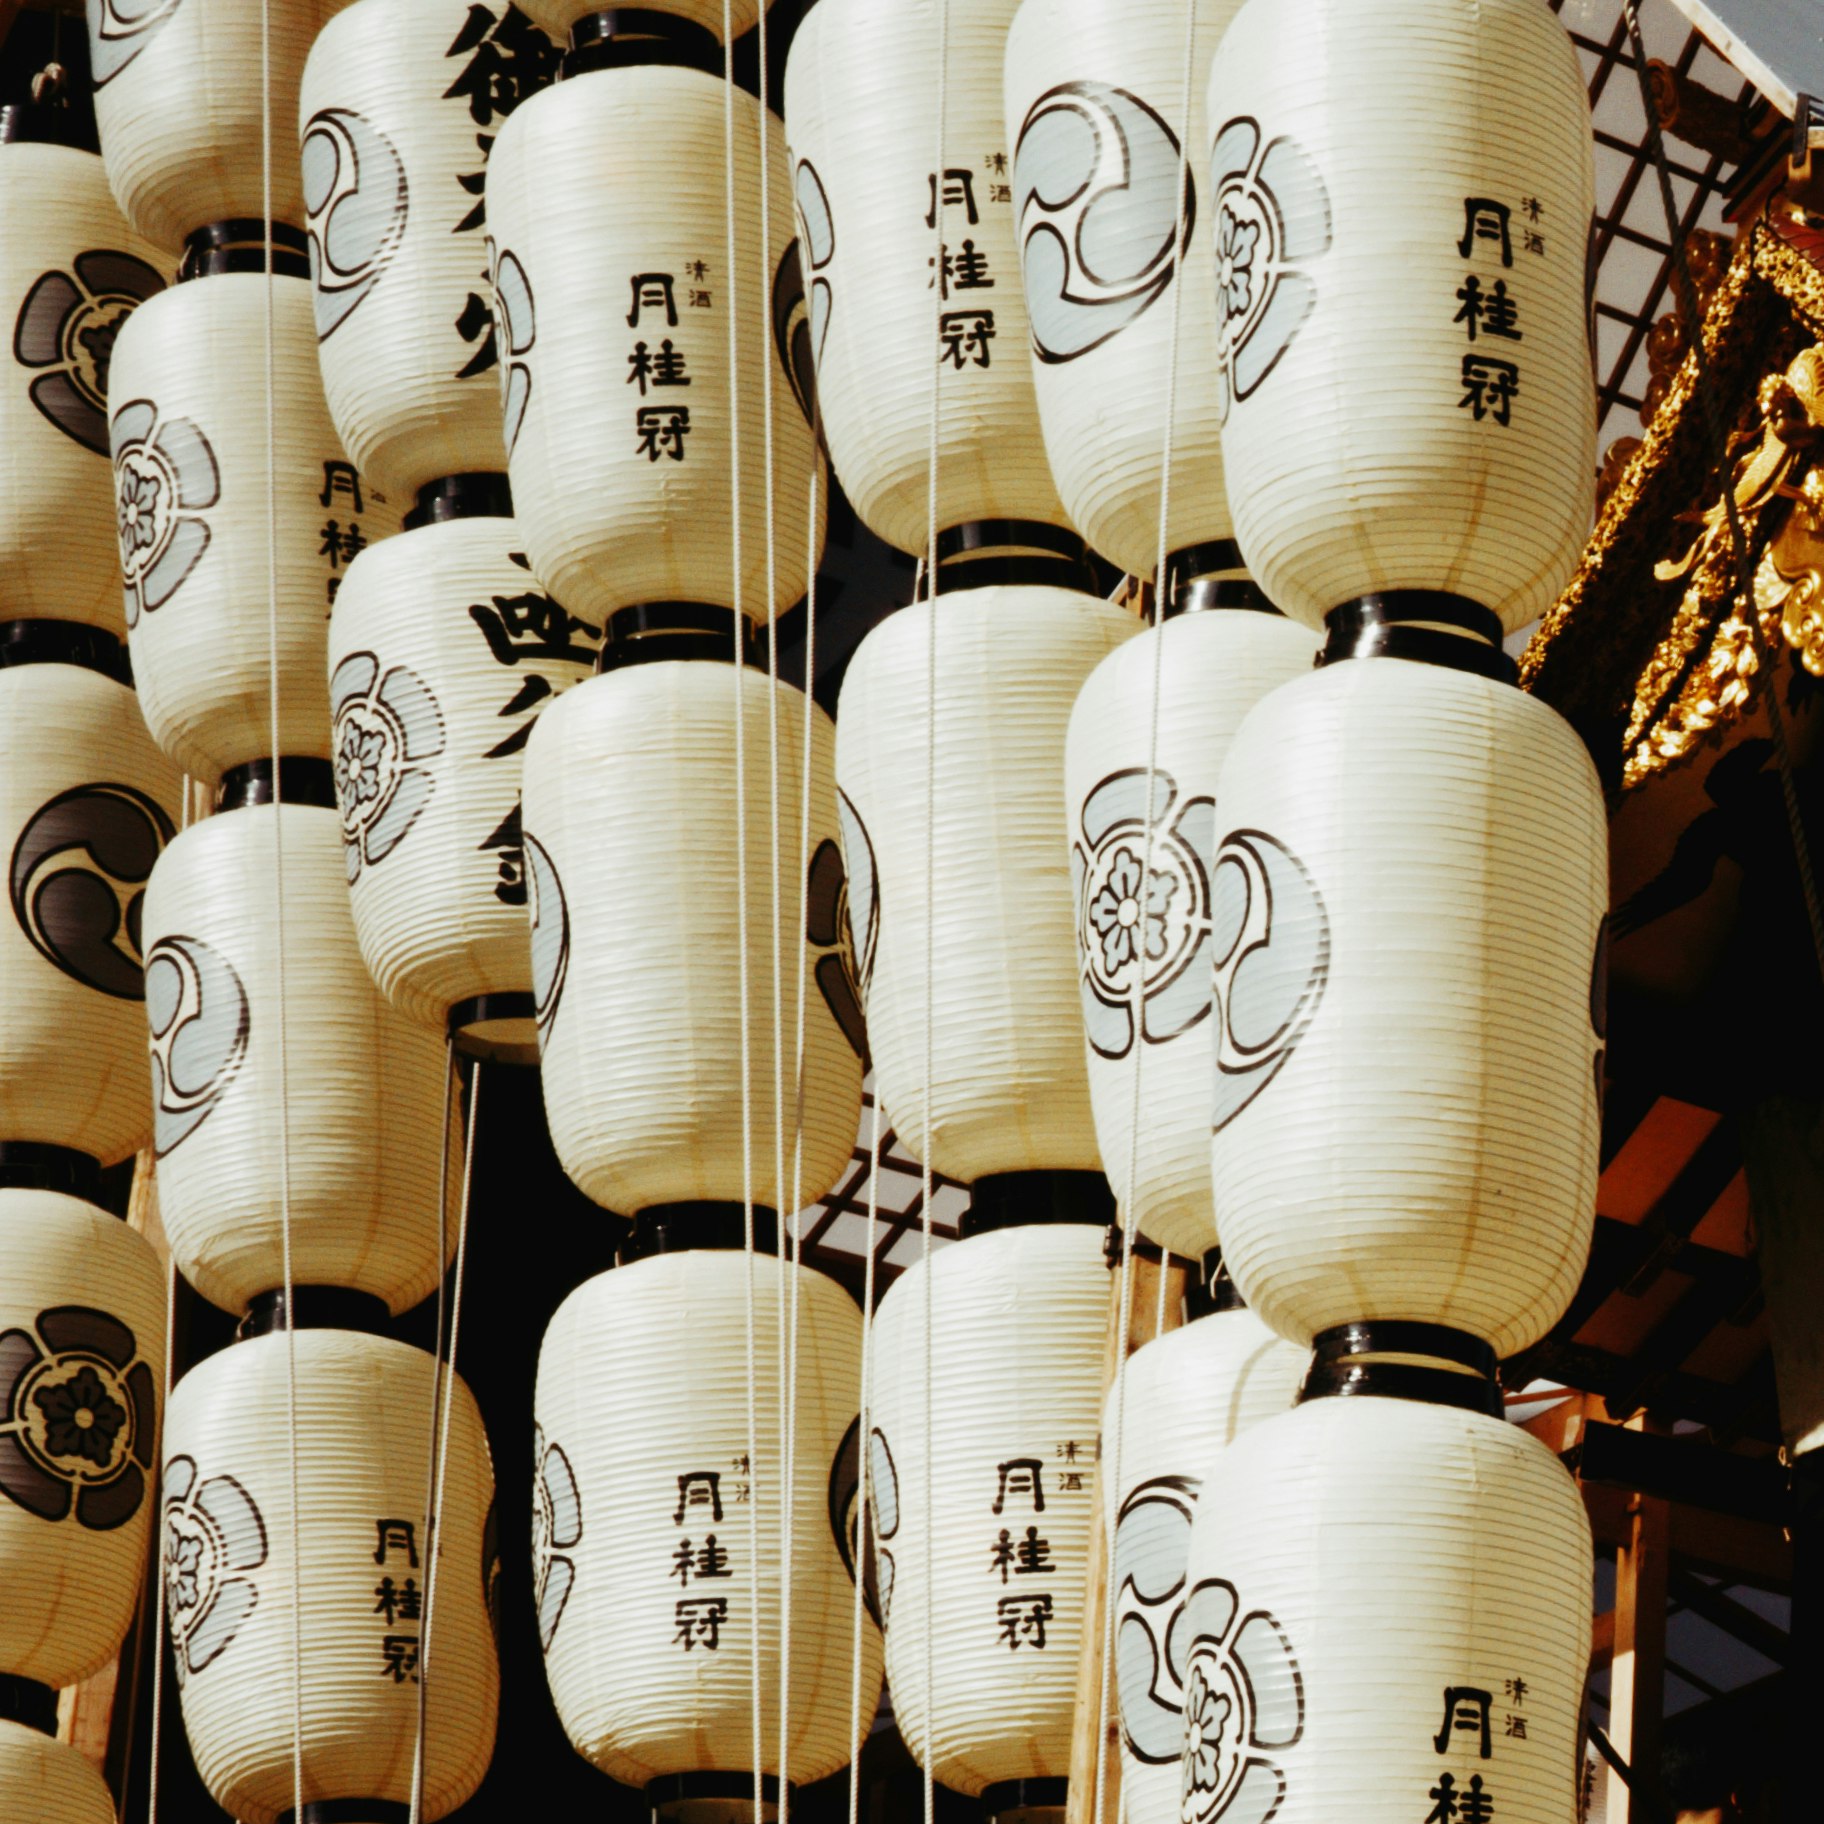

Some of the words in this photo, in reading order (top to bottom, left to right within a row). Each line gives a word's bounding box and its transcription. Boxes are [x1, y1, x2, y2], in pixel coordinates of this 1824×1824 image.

[924, 168, 996, 370] 月桂冠
[1455, 198, 1524, 427] 月桂冠
[1521, 195, 1547, 257] 清酒
[626, 272, 693, 464] 月桂冠
[990, 1458, 1055, 1650] 月桂冠
[1056, 1440, 1083, 1492] 清酒
[670, 1471, 734, 1652] 月桂冠
[1504, 1676, 1530, 1741] 清酒
